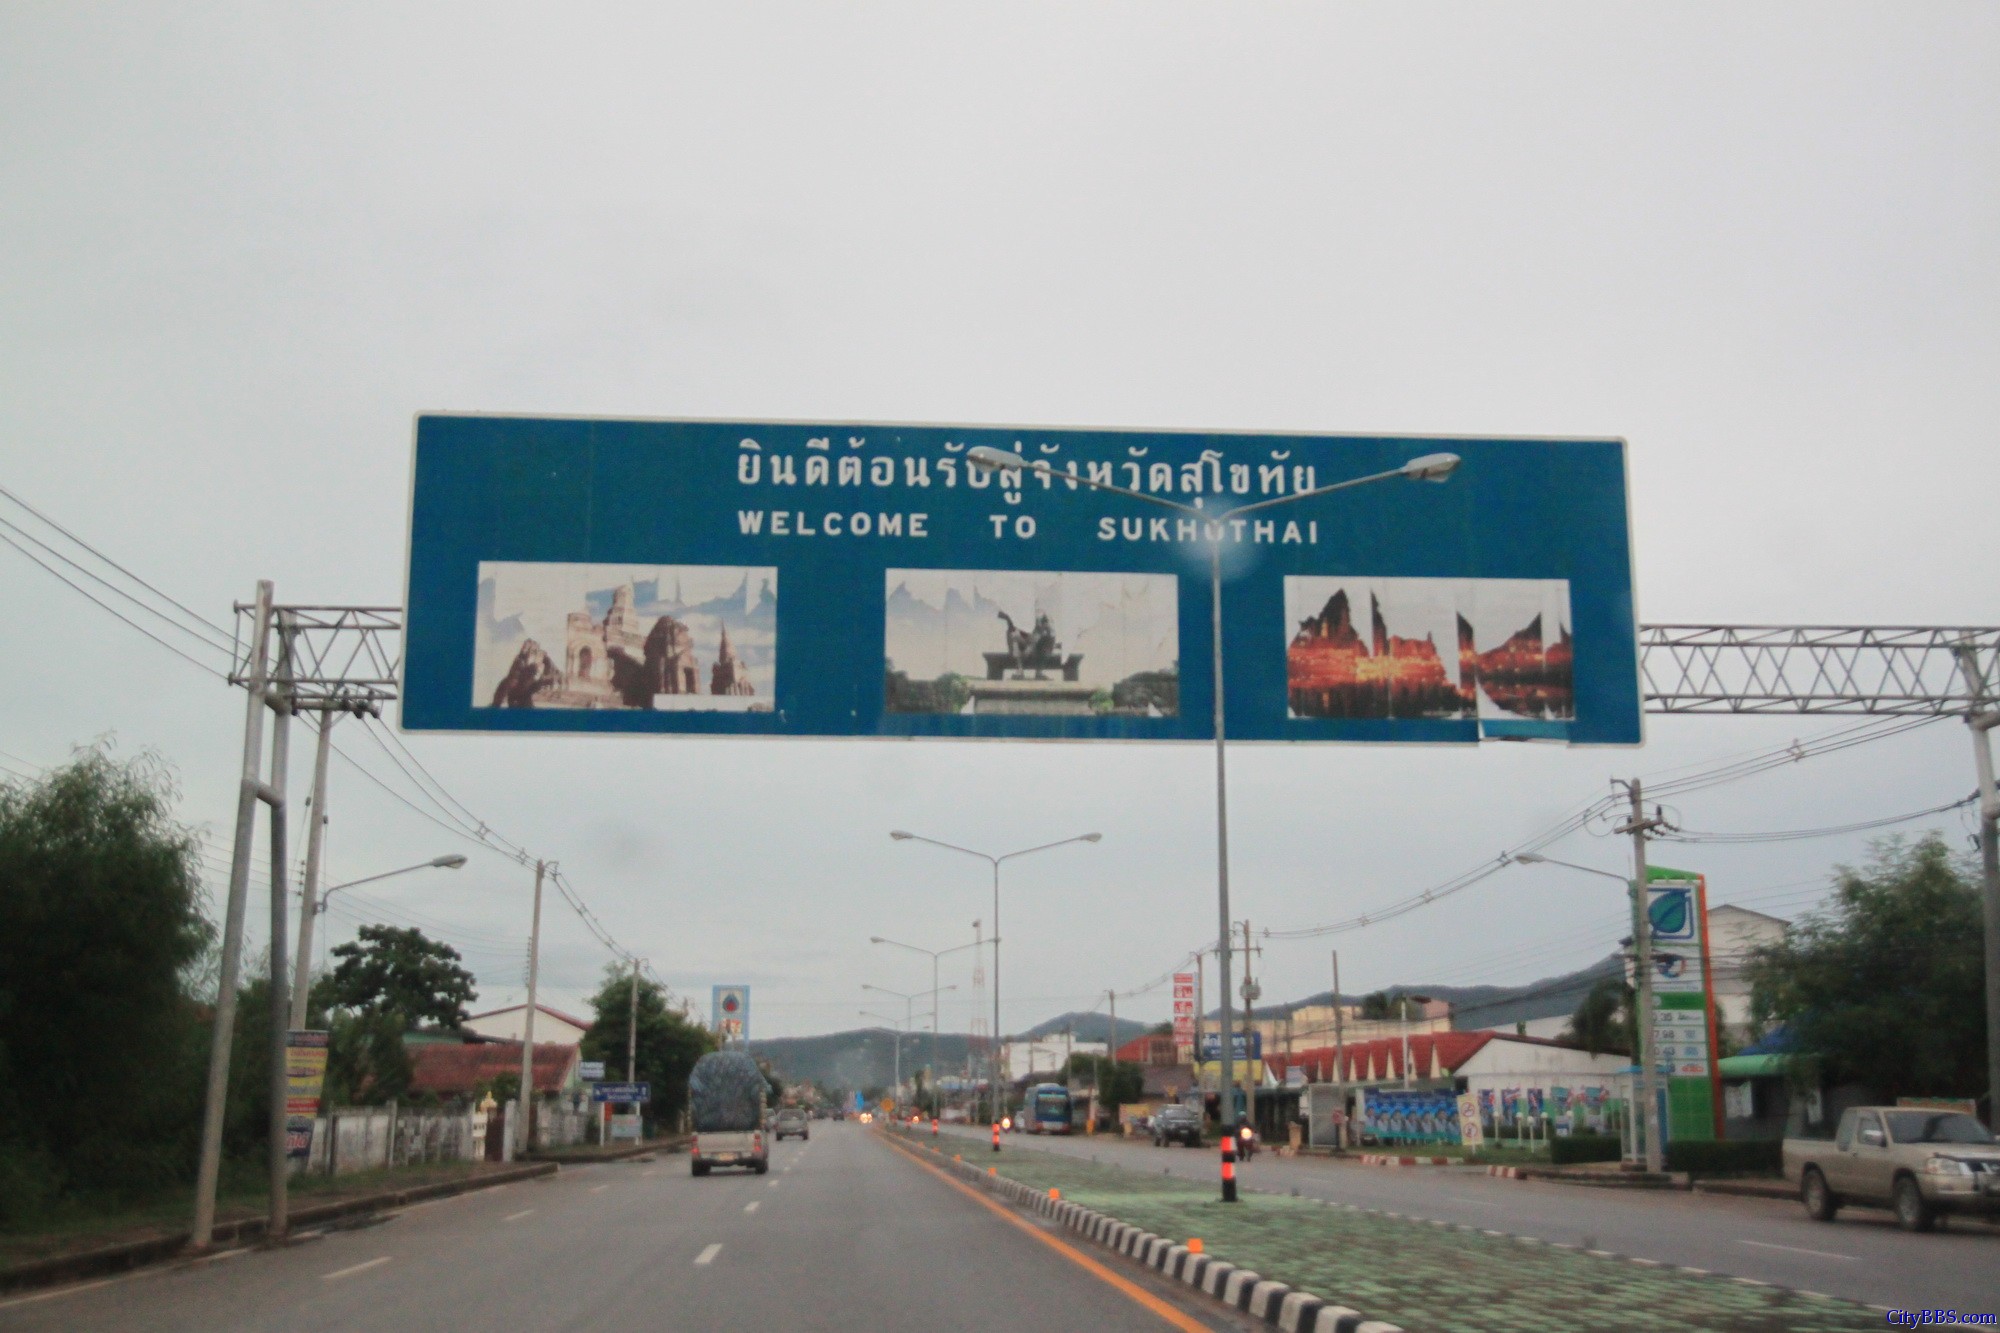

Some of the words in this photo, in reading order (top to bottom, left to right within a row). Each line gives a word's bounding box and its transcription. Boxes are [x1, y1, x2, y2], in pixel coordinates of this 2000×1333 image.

[737, 436, 1316, 510] ยินดีต้อนรับสู่จังหวัดสุโขทัย
[737, 510, 929, 538] WELCOME
[989, 514, 1037, 540] TO
[1097, 516, 1318, 545] SUKHOTHAI
